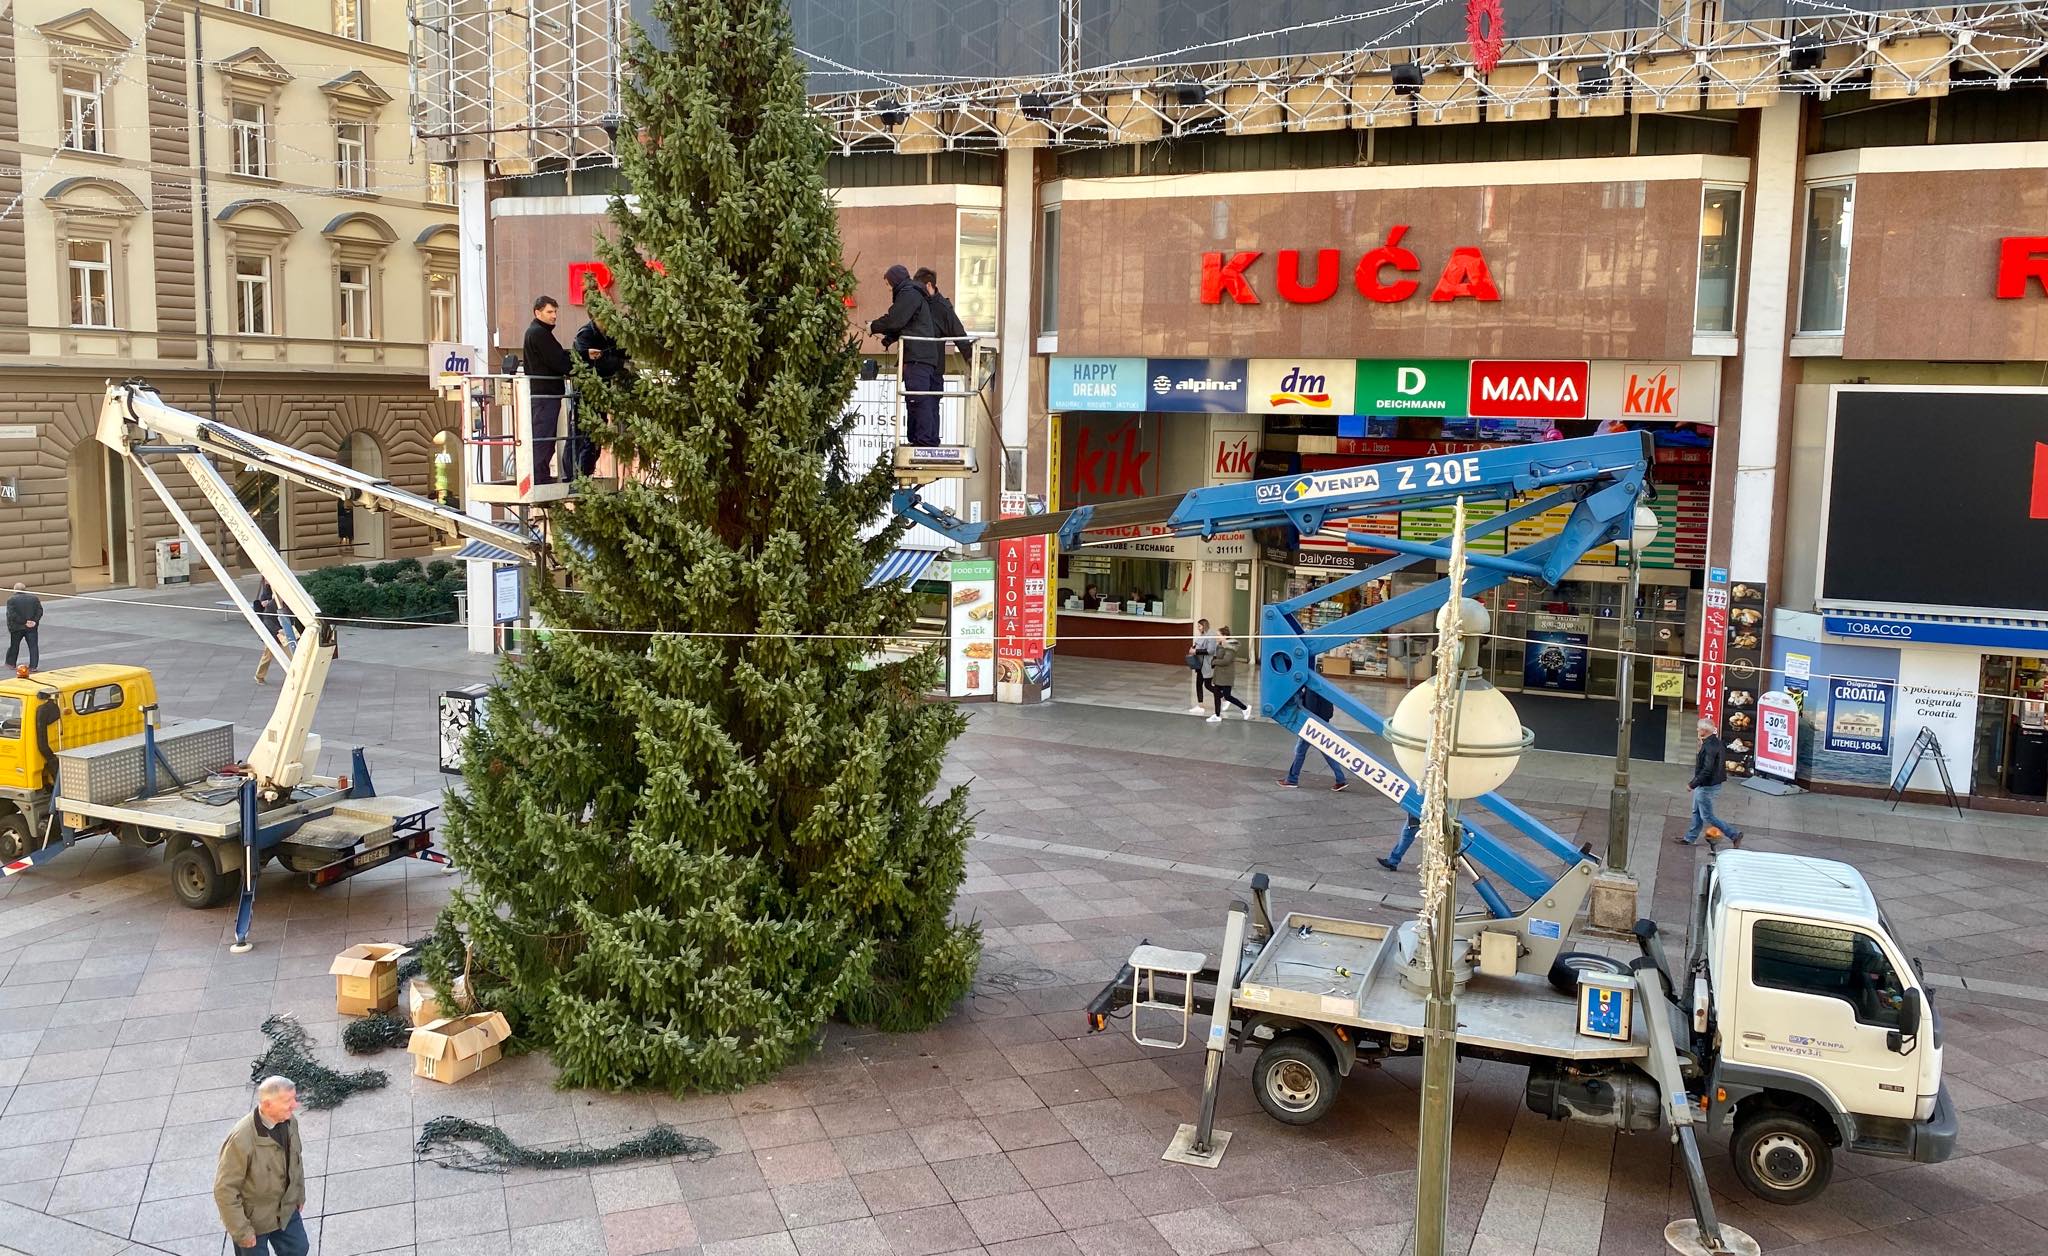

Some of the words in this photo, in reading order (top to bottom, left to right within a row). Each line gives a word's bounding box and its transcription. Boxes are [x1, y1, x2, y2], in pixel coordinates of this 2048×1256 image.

[1200, 225, 1502, 304] KUĆA
[445, 351, 469, 372] dm
[1073, 364, 1117, 380] HAPPY
[1175, 378, 1238, 393] alpina
[1280, 367, 1326, 393] dm
[1397, 367, 1427, 395] D
[1073, 383, 1117, 397] DREAMS
[1481, 376, 1579, 401] MANA
[1624, 370, 1676, 413] kik
[1376, 400, 1446, 409] DEICHMANN
[1071, 427, 1152, 496] kik
[1216, 438, 1255, 473] kik
[1397, 466, 1417, 490] Z
[1425, 458, 1481, 487] 20E
[1258, 484, 1282, 498] GV3
[1314, 474, 1378, 493] VENPA
[1135, 544, 1175, 552] EXCHANGE
[1216, 546, 1244, 554] 311111
[1299, 553, 1355, 566] DailyPress
[960, 627, 985, 636] Snack
[1847, 622, 1912, 636] TOBACCO
[999, 647, 1023, 657] CLUB
[1834, 686, 1886, 702] CROATIA
[1915, 697, 1962, 708] osigurala
[1917, 708, 1958, 719] Croatia.
[1765, 716, 1787, 729] -30%
[1769, 737, 1791, 751] -30%
[1304, 724, 1405, 798] www.gv3.it
[1816, 1040, 1845, 1049] VENPA
